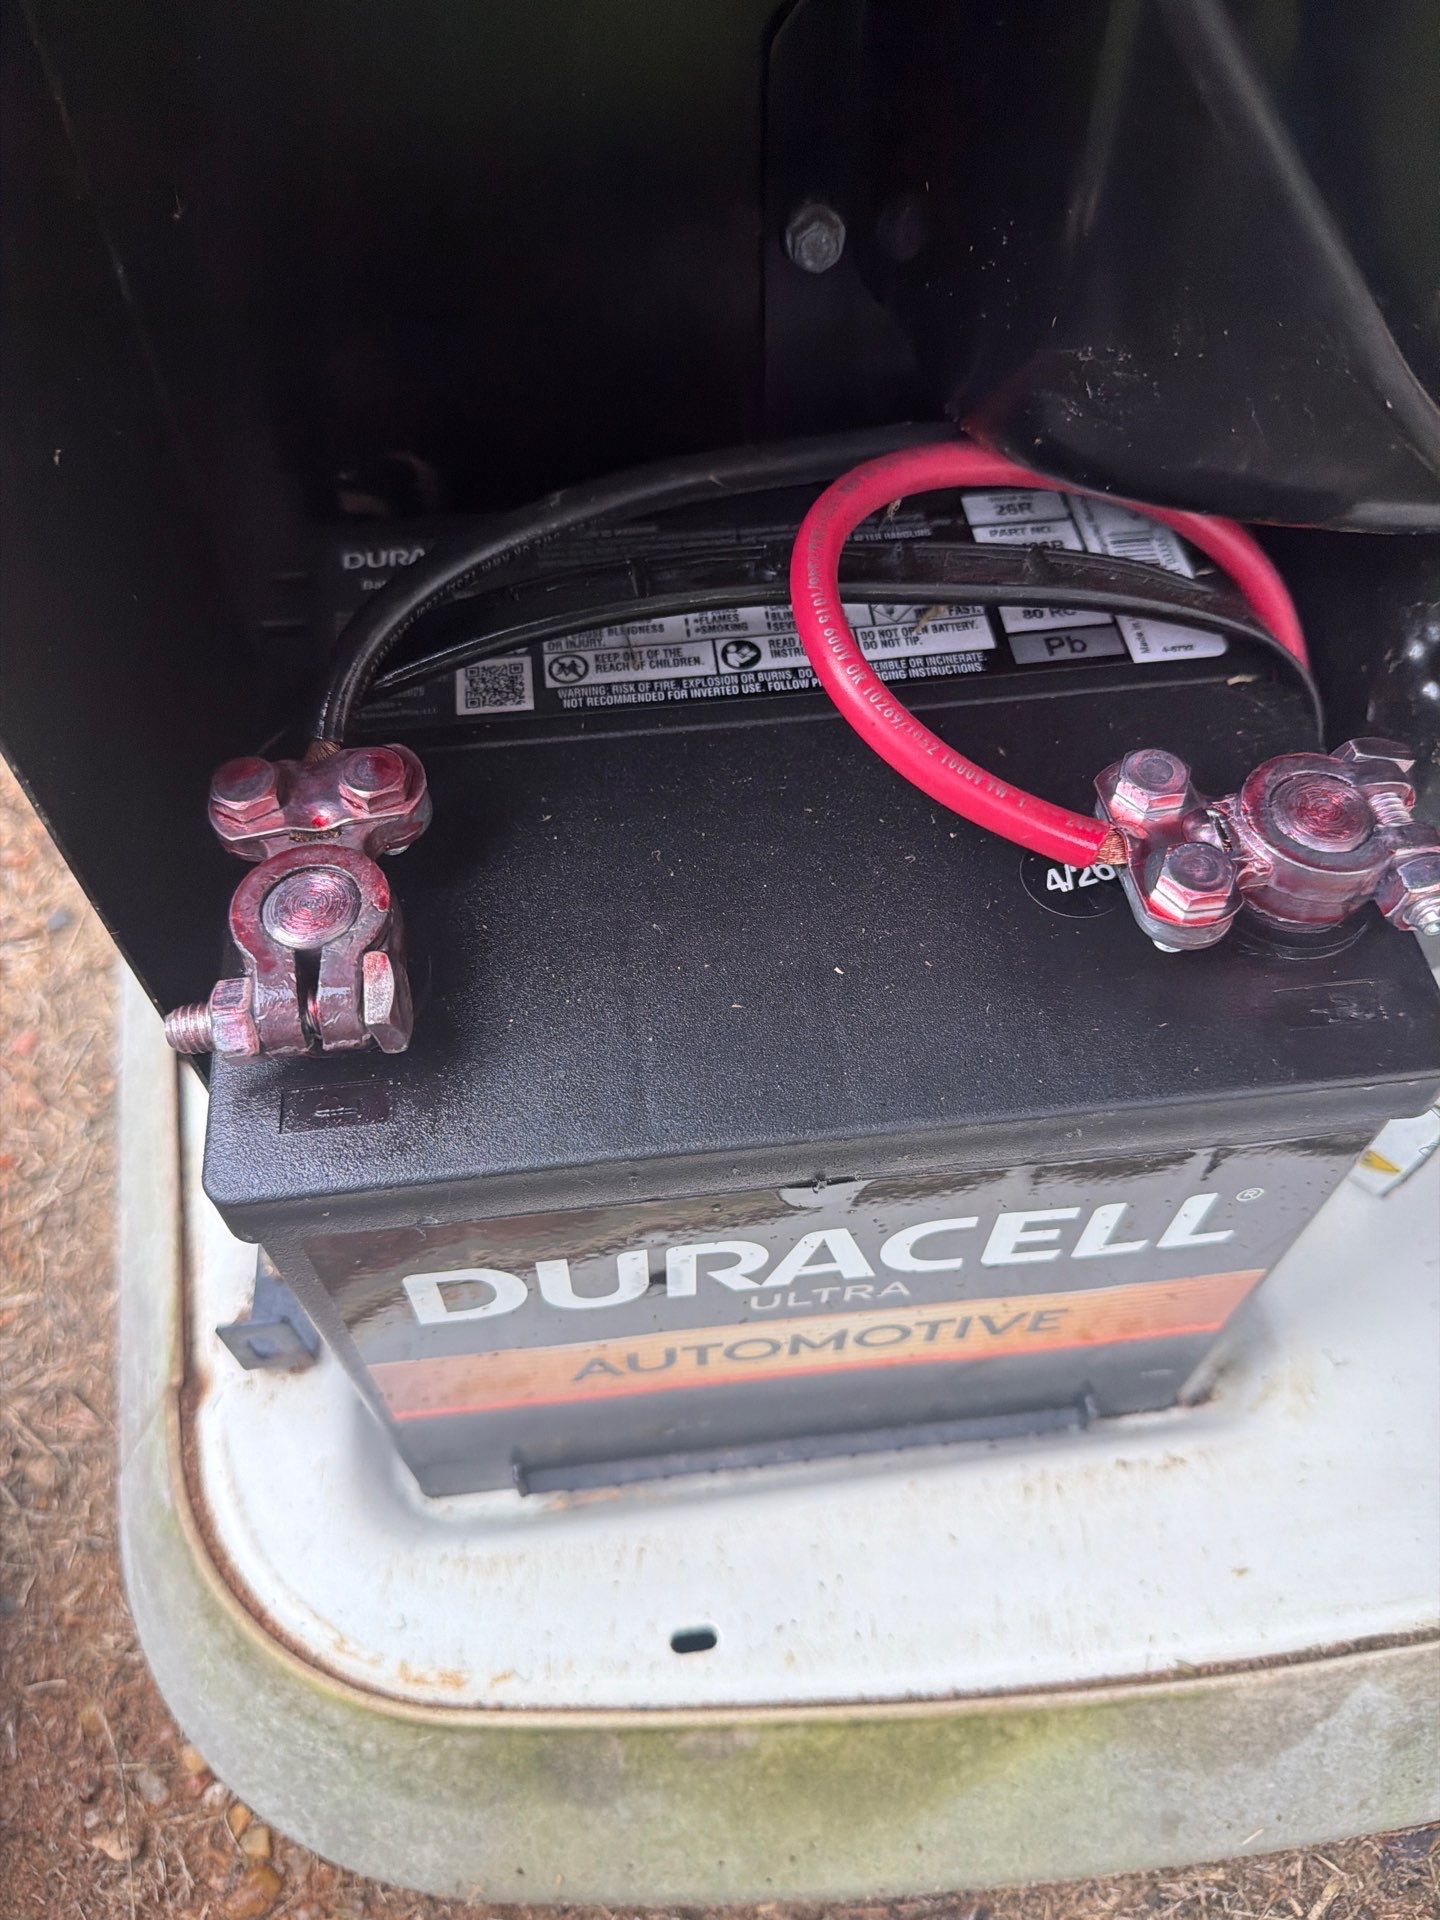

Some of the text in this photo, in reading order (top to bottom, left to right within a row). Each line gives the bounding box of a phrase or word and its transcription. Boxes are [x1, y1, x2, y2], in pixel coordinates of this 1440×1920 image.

[989, 527, 1025, 538] PART
[342, 548, 426, 569] DURA
[860, 630, 876, 641] DO
[878, 628, 899, 639] NOT
[931, 621, 979, 634] BATTERY.
[768, 638, 796, 649] READ
[862, 636, 923, 651] DO NOT TIP.
[1043, 635, 1087, 657] Pb
[595, 652, 620, 663] KEEP
[646, 649, 660, 660] OF
[664, 647, 683, 658] THE
[596, 662, 630, 674] REACH
[649, 656, 705, 669] CHILDREN.
[823, 627, 851, 663] 600V
[846, 663, 868, 686] OR
[909, 657, 924, 669] OR
[926, 651, 988, 666] INCINERATE.
[908, 662, 986, 678] INSTRUCTIONS.
[557, 685, 609, 699] WARNING:
[611, 683, 636, 695] RISK
[637, 681, 652, 693] OF
[682, 674, 738, 689] EXPLOSION
[740, 672, 755, 684] OR
[757, 670, 796, 682] BURNS.
[798, 668, 813, 679] DO
[562, 696, 584, 709] NOT
[586, 690, 665, 707] RECOMMENDED
[667, 686, 688, 700] FOR
[690, 683, 739, 698] INVERTED
[742, 681, 766, 694] USE.
[768, 679, 809, 692] FOLLOW
[402, 1193, 1235, 1325] DURACELL
[750, 1280, 911, 1311] ULTRA
[573, 1308, 1070, 1382] AUTOMOTIVE
